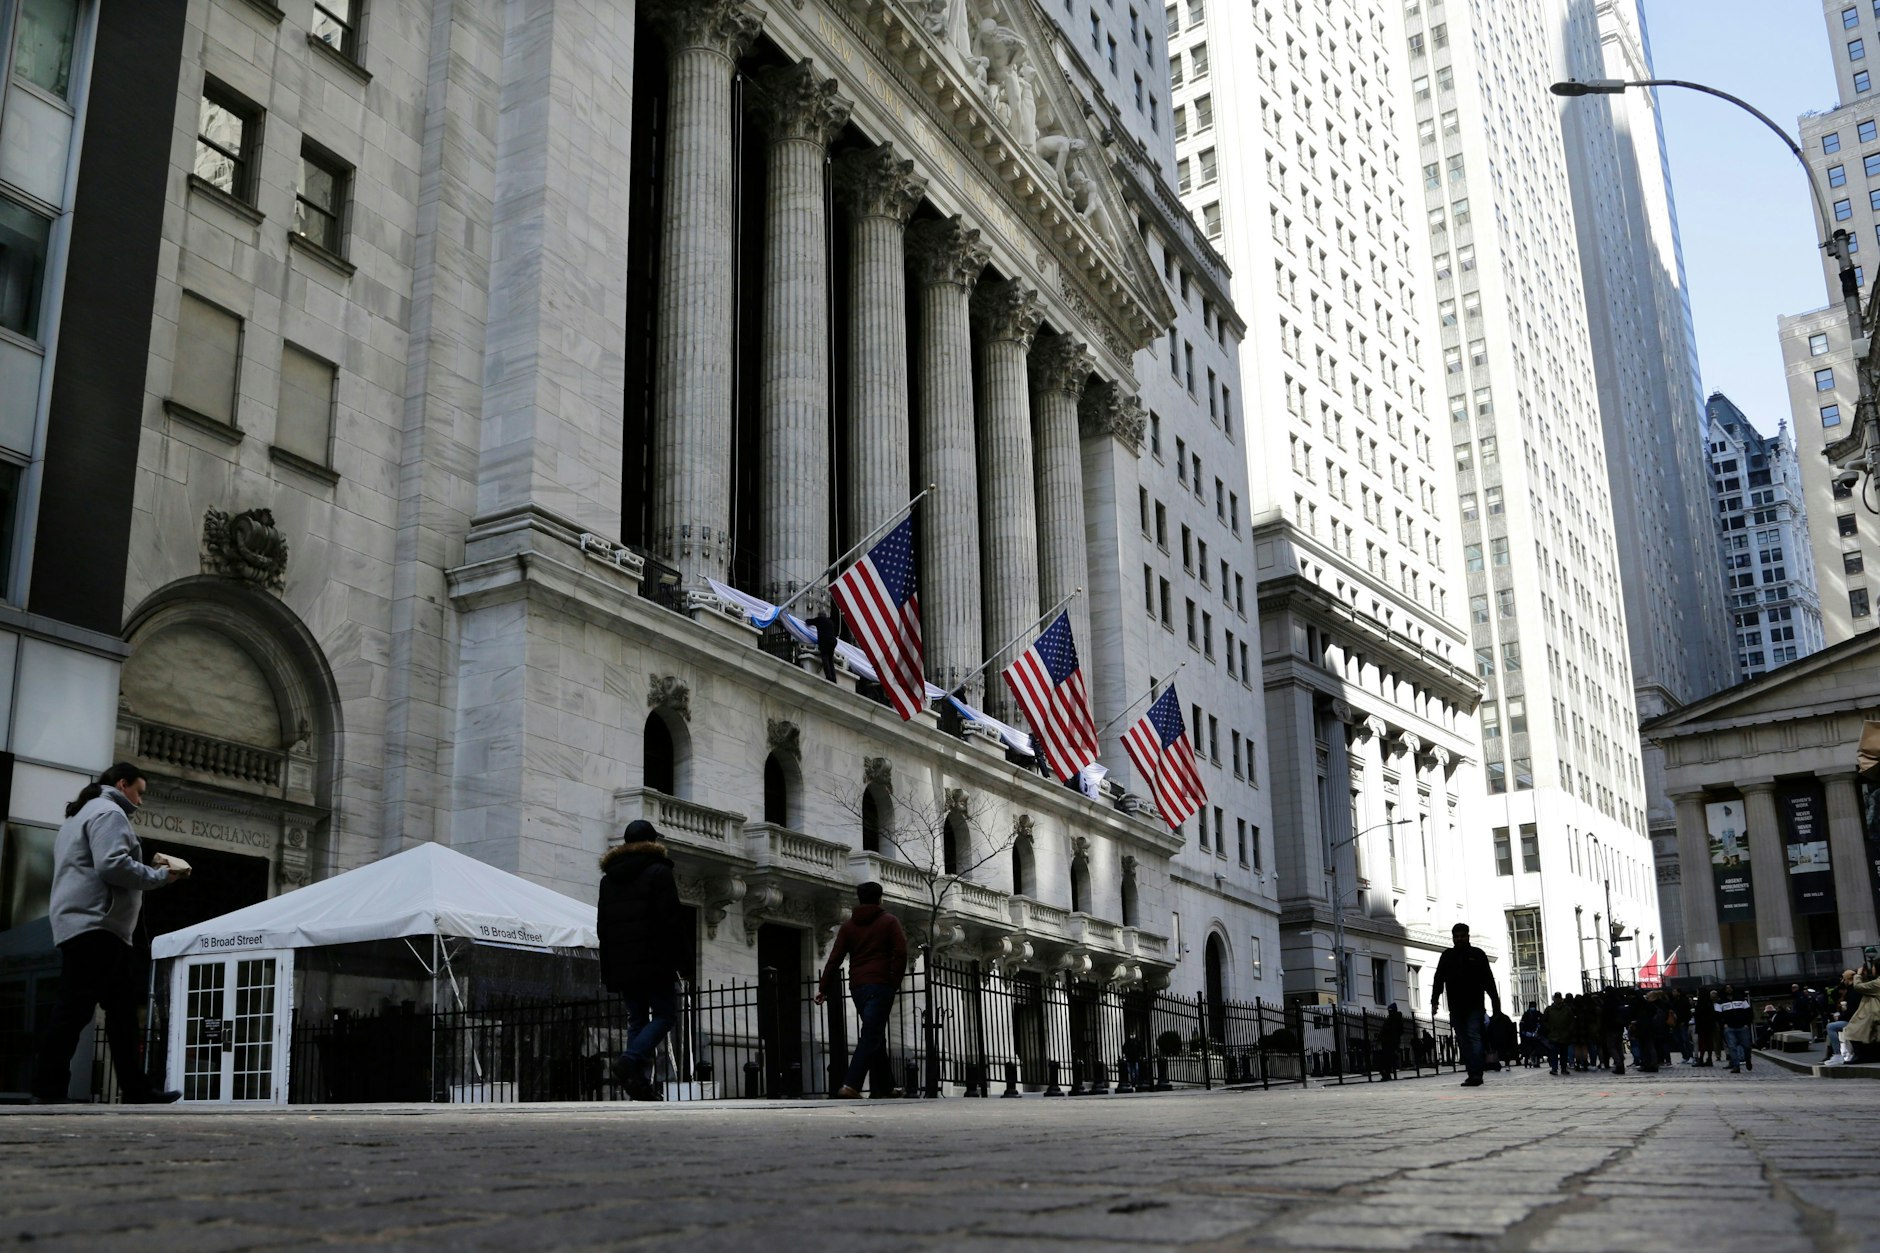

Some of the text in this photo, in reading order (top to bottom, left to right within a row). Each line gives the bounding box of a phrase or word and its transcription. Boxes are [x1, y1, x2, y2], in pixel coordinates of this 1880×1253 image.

[818, 13, 1027, 251] NEW YORK STOCK EXCHANGE
[133, 810, 270, 848] STOCK EXCHANGE
[200, 934, 263, 948] 18 Broad Street
[480, 925, 544, 943] 18 Broad Street
